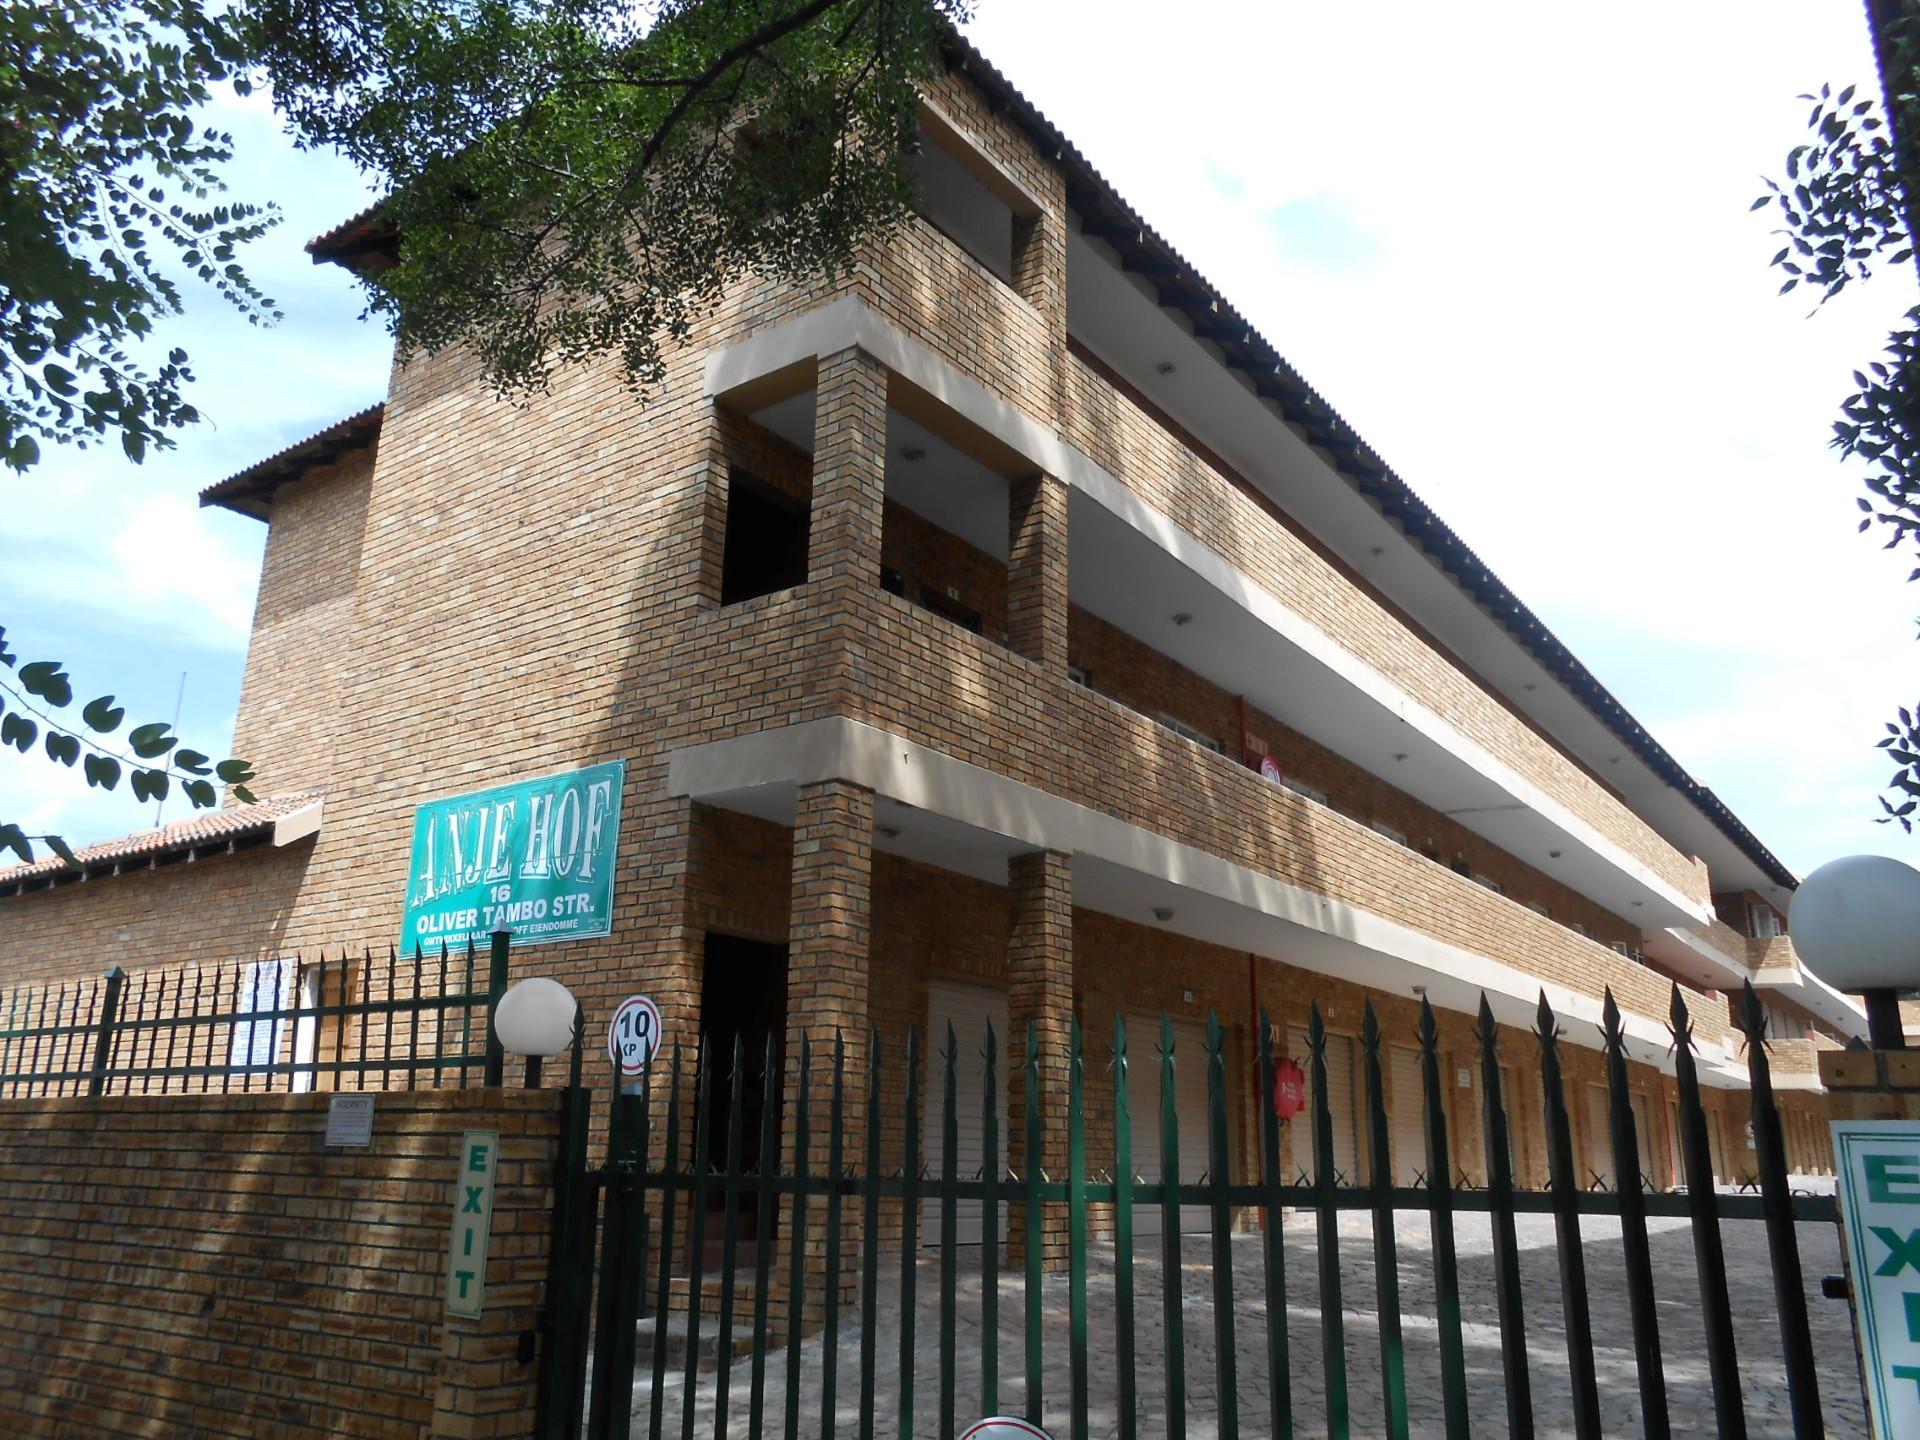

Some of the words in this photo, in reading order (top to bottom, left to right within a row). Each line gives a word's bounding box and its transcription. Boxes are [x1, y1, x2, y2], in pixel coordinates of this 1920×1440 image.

[411, 800, 515, 907] ANJE
[520, 779, 612, 881] HOF
[416, 908, 479, 935] OLIVER
[483, 900, 548, 926] TAMBO
[552, 893, 595, 916] STR.
[490, 884, 511, 903] 16
[620, 1010, 650, 1038] 10
[455, 1145, 489, 1299] EXIT
